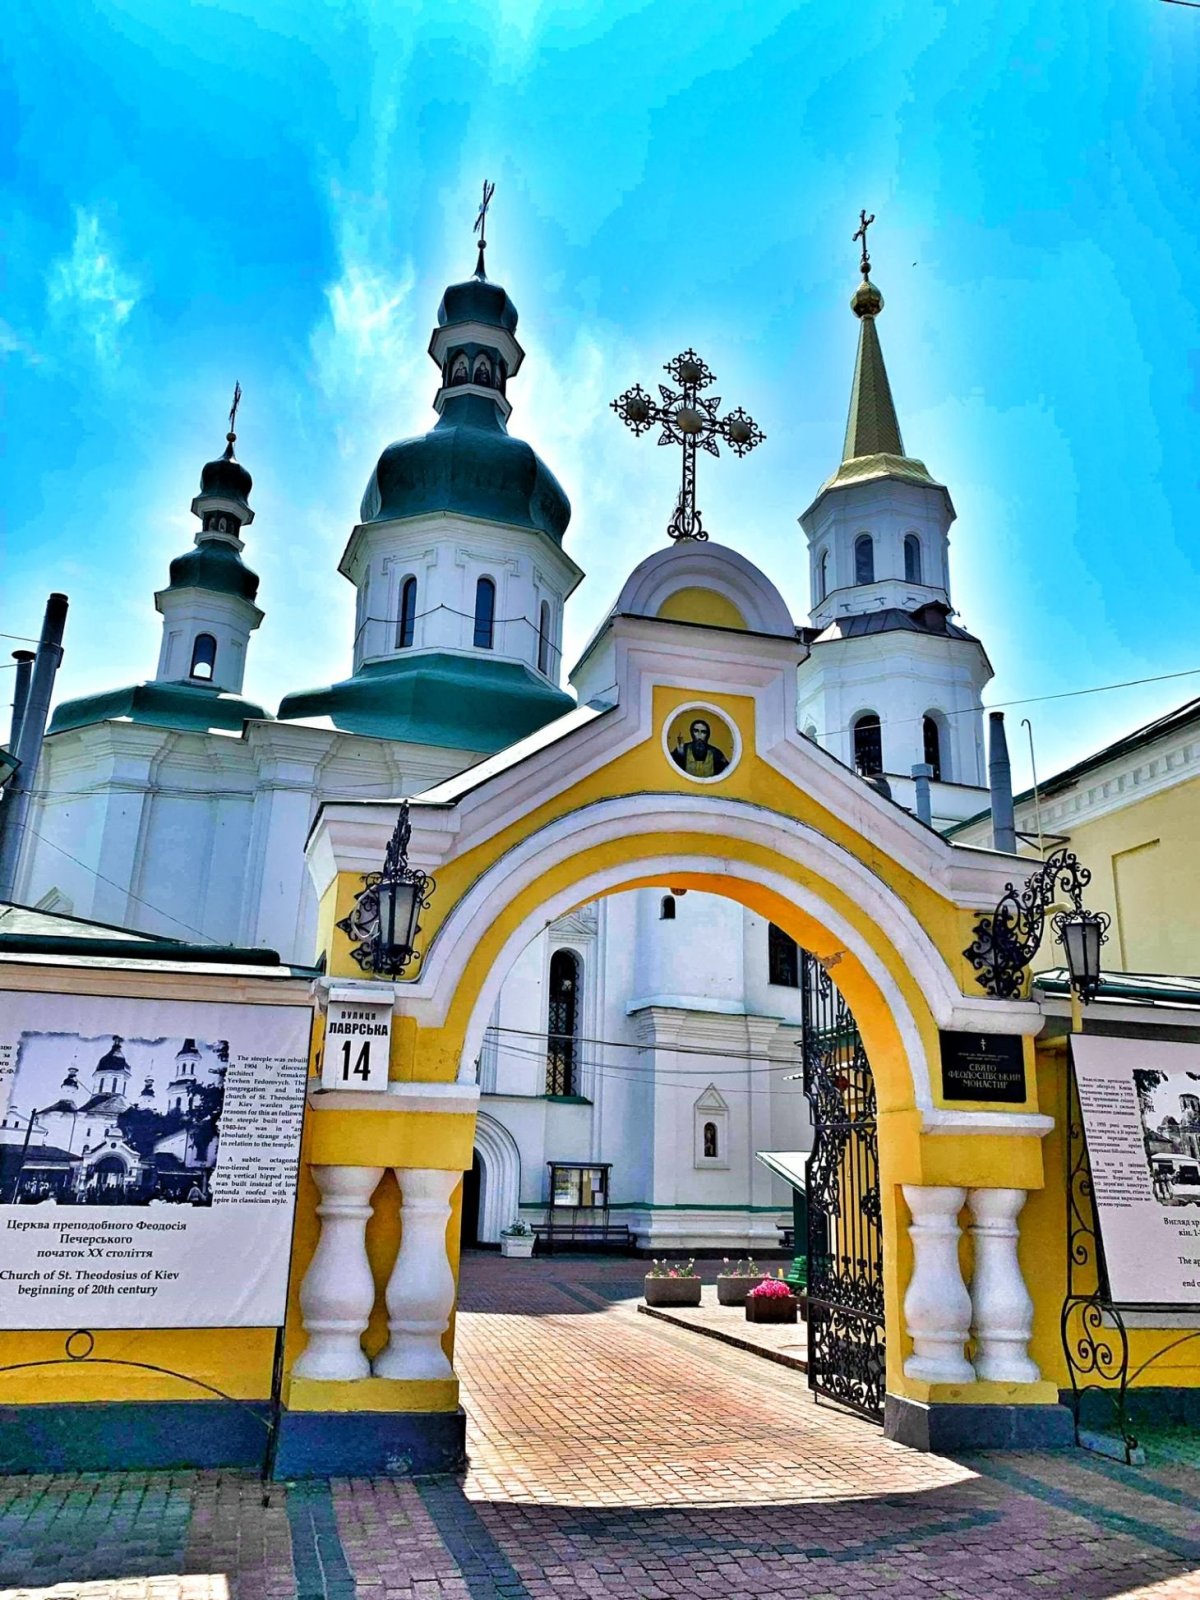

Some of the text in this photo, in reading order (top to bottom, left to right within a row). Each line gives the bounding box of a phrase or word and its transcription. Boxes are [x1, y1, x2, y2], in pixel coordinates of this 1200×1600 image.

[341, 1011, 376, 1020] ВУЛИЦЯ
[329, 1022, 388, 1036] ЛАВРСЬКА
[250, 1055, 272, 1063] steeple
[341, 1040, 371, 1081] 14
[7, 1219, 187, 1231] Церква преподобного Феодосія
[1164, 1218, 1190, 1226] Вигляд
[59, 1234, 133, 1246] Печерського
[36, 1250, 85, 1258] початок
[106, 1248, 153, 1258] століття
[0, 1270, 179, 1280] Church of St. Theodosius of Kiev
[1182, 1279, 1195, 1287] end
[18, 1284, 158, 1297] beginning of 20th century
